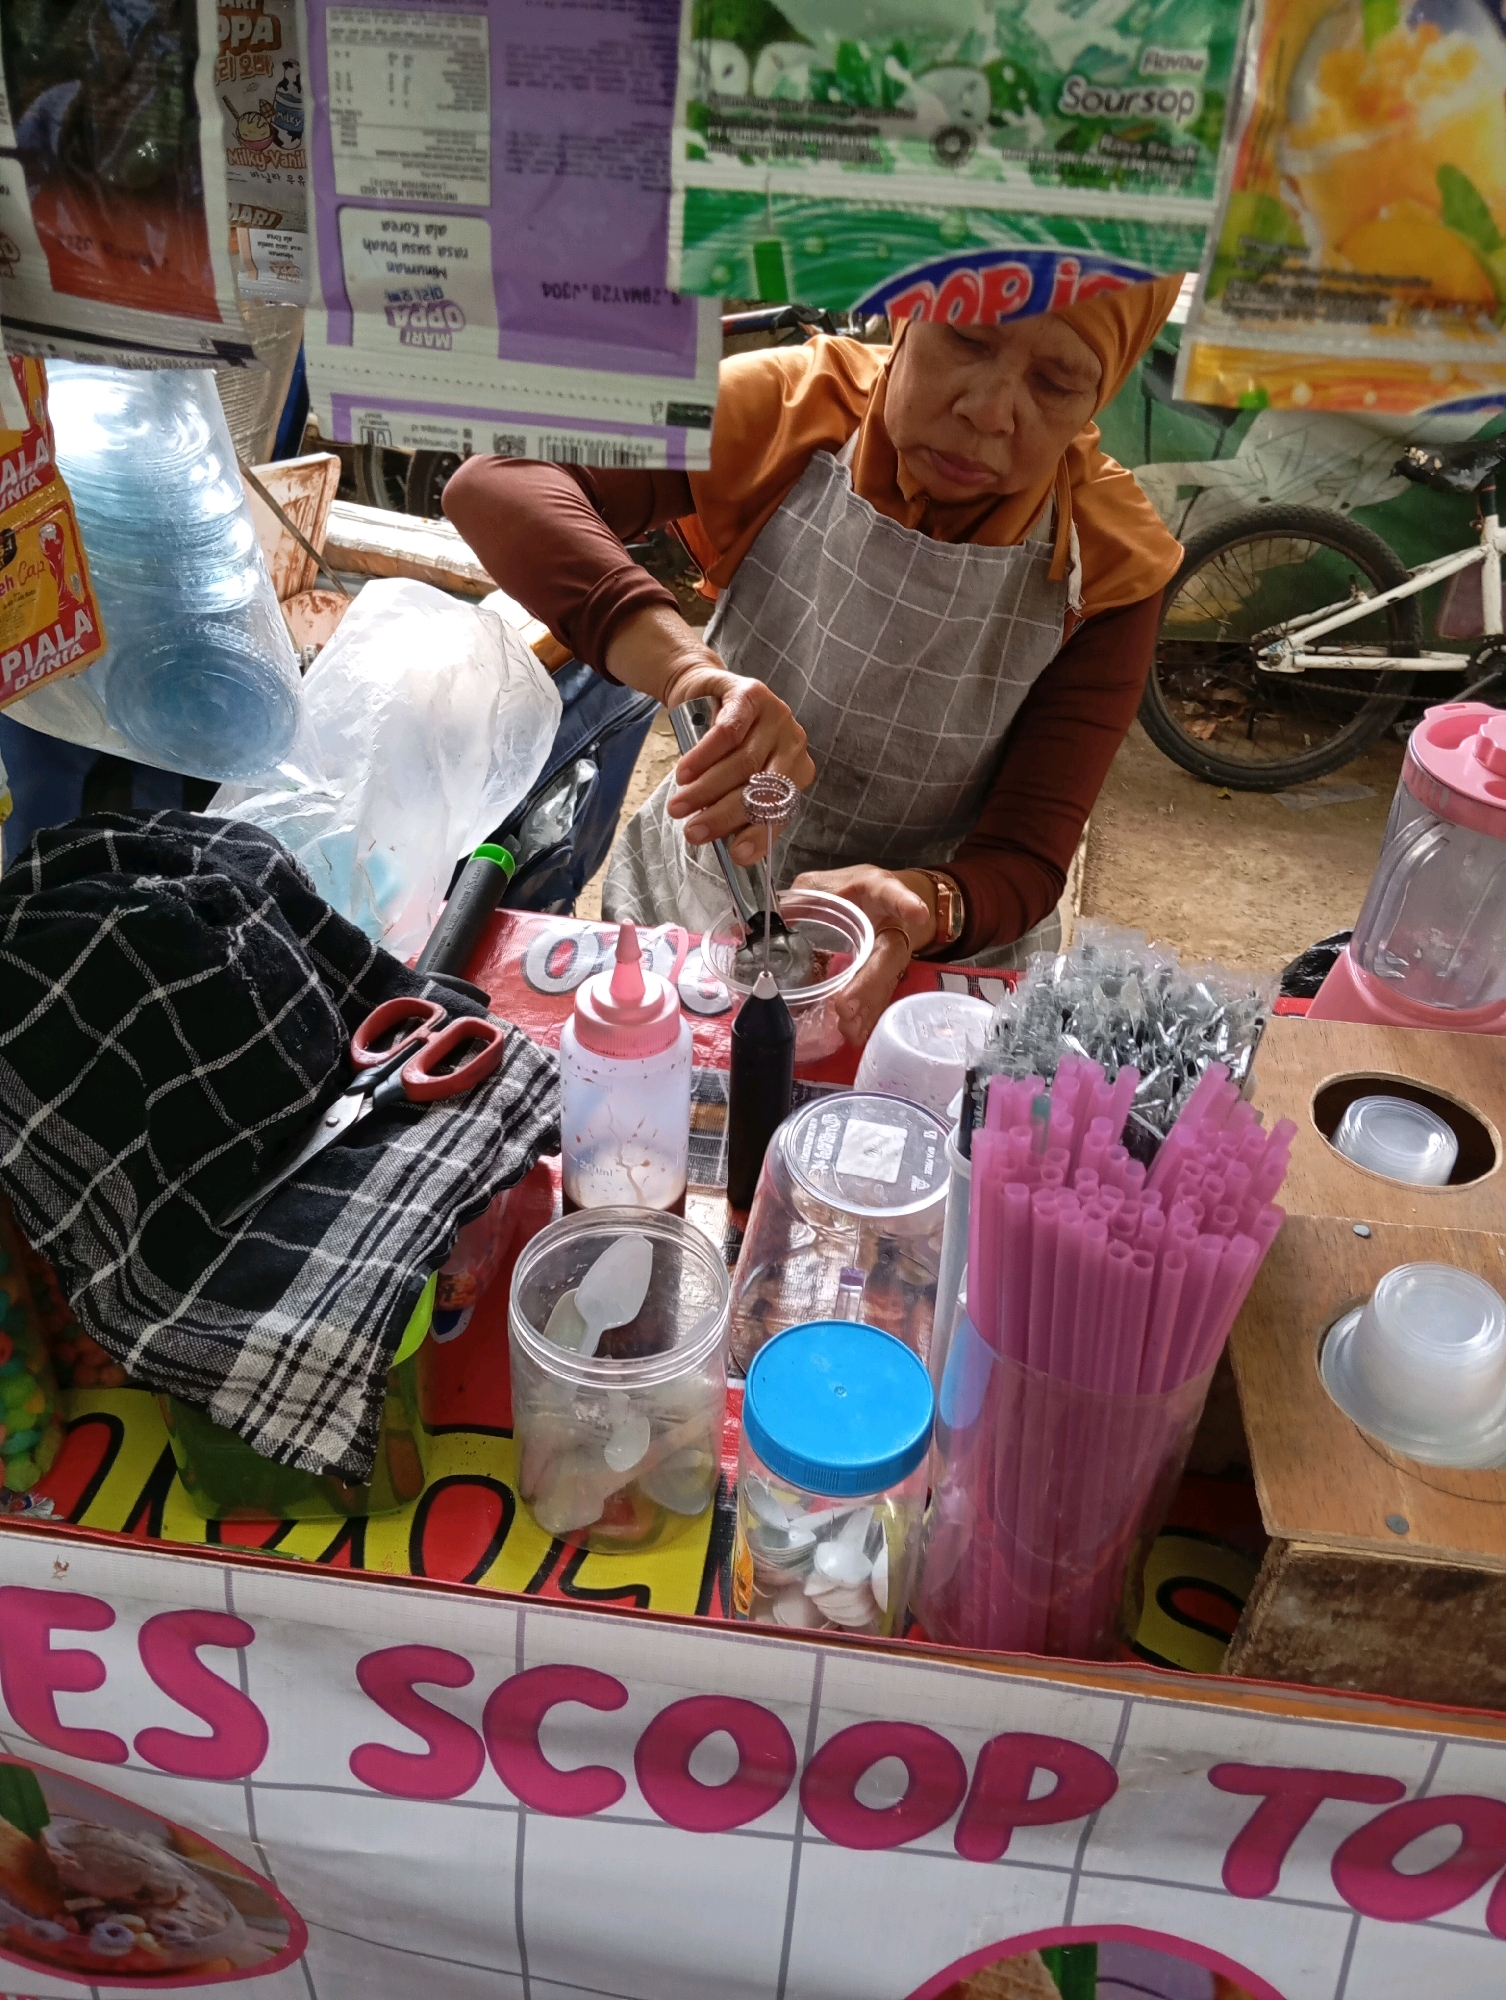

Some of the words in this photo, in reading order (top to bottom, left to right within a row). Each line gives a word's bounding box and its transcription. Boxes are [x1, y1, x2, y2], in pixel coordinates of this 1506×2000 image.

[1060, 79, 1196, 124] Soursop
[276, 111, 302, 127] Milky
[226, 148, 268, 171] Milky
[268, 149, 307, 169] Vanil
[380, 220, 420, 238] Korea
[362, 238, 398, 259] buah
[401, 243, 432, 257] susu
[437, 246, 469, 260] rasa
[385, 261, 448, 281] Minuman
[391, 306, 466, 330] OPPA
[404, 330, 453, 349] MARI
[0, 437, 50, 492] ALA
[0, 473, 42, 511] NIA
[0, 575, 14, 599] eh
[17, 560, 46, 586] Cap
[1, 608, 94, 684] PIALA
[14, 643, 85, 692] DUNIA
[0, 1585, 270, 1782] ES
[349, 1644, 1119, 1864] SCOOP
[1207, 1761, 1506, 1943] TO
